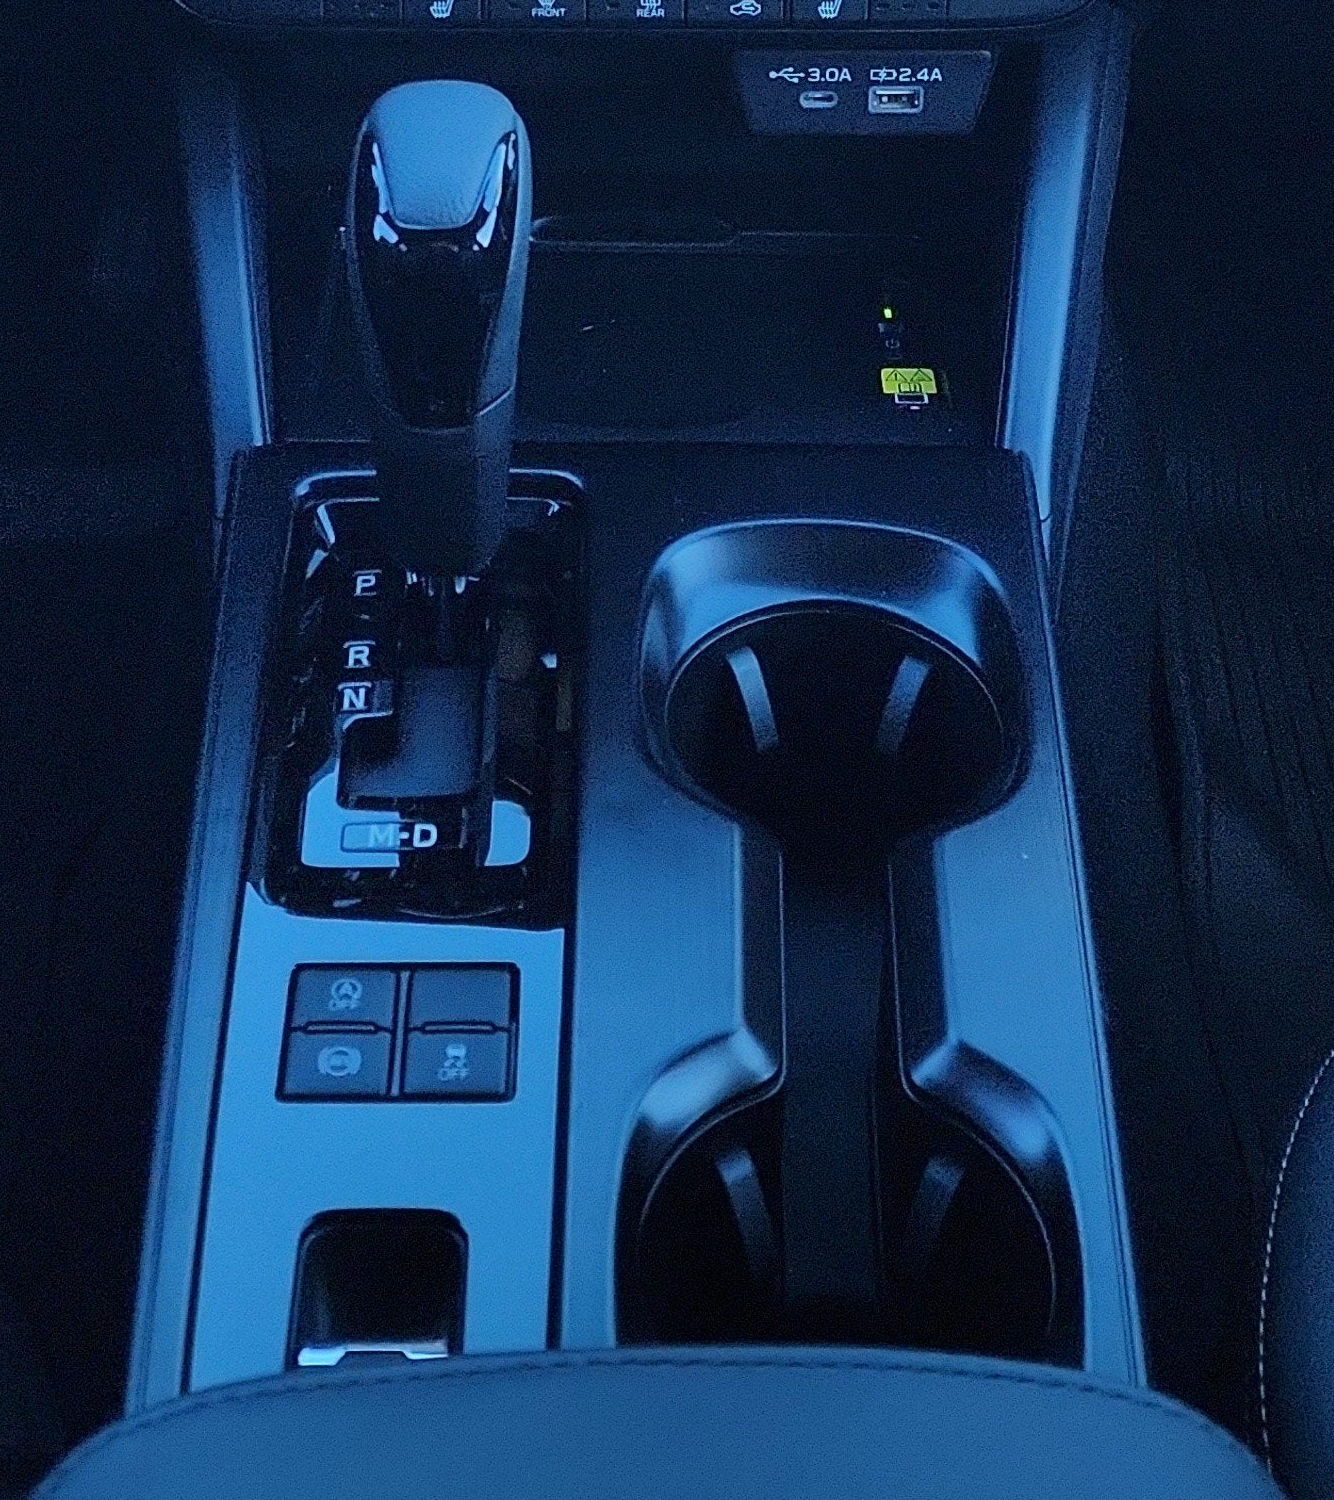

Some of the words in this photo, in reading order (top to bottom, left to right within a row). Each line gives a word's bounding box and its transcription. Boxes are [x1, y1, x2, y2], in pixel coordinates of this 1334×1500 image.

[531, 7, 565, 17] FRONT
[636, 8, 665, 18] REAR
[807, 68, 852, 82] 3.0A
[898, 68, 943, 82] 2.4A
[356, 575, 376, 594] P
[348, 645, 370, 667] R
[342, 687, 366, 710] N
